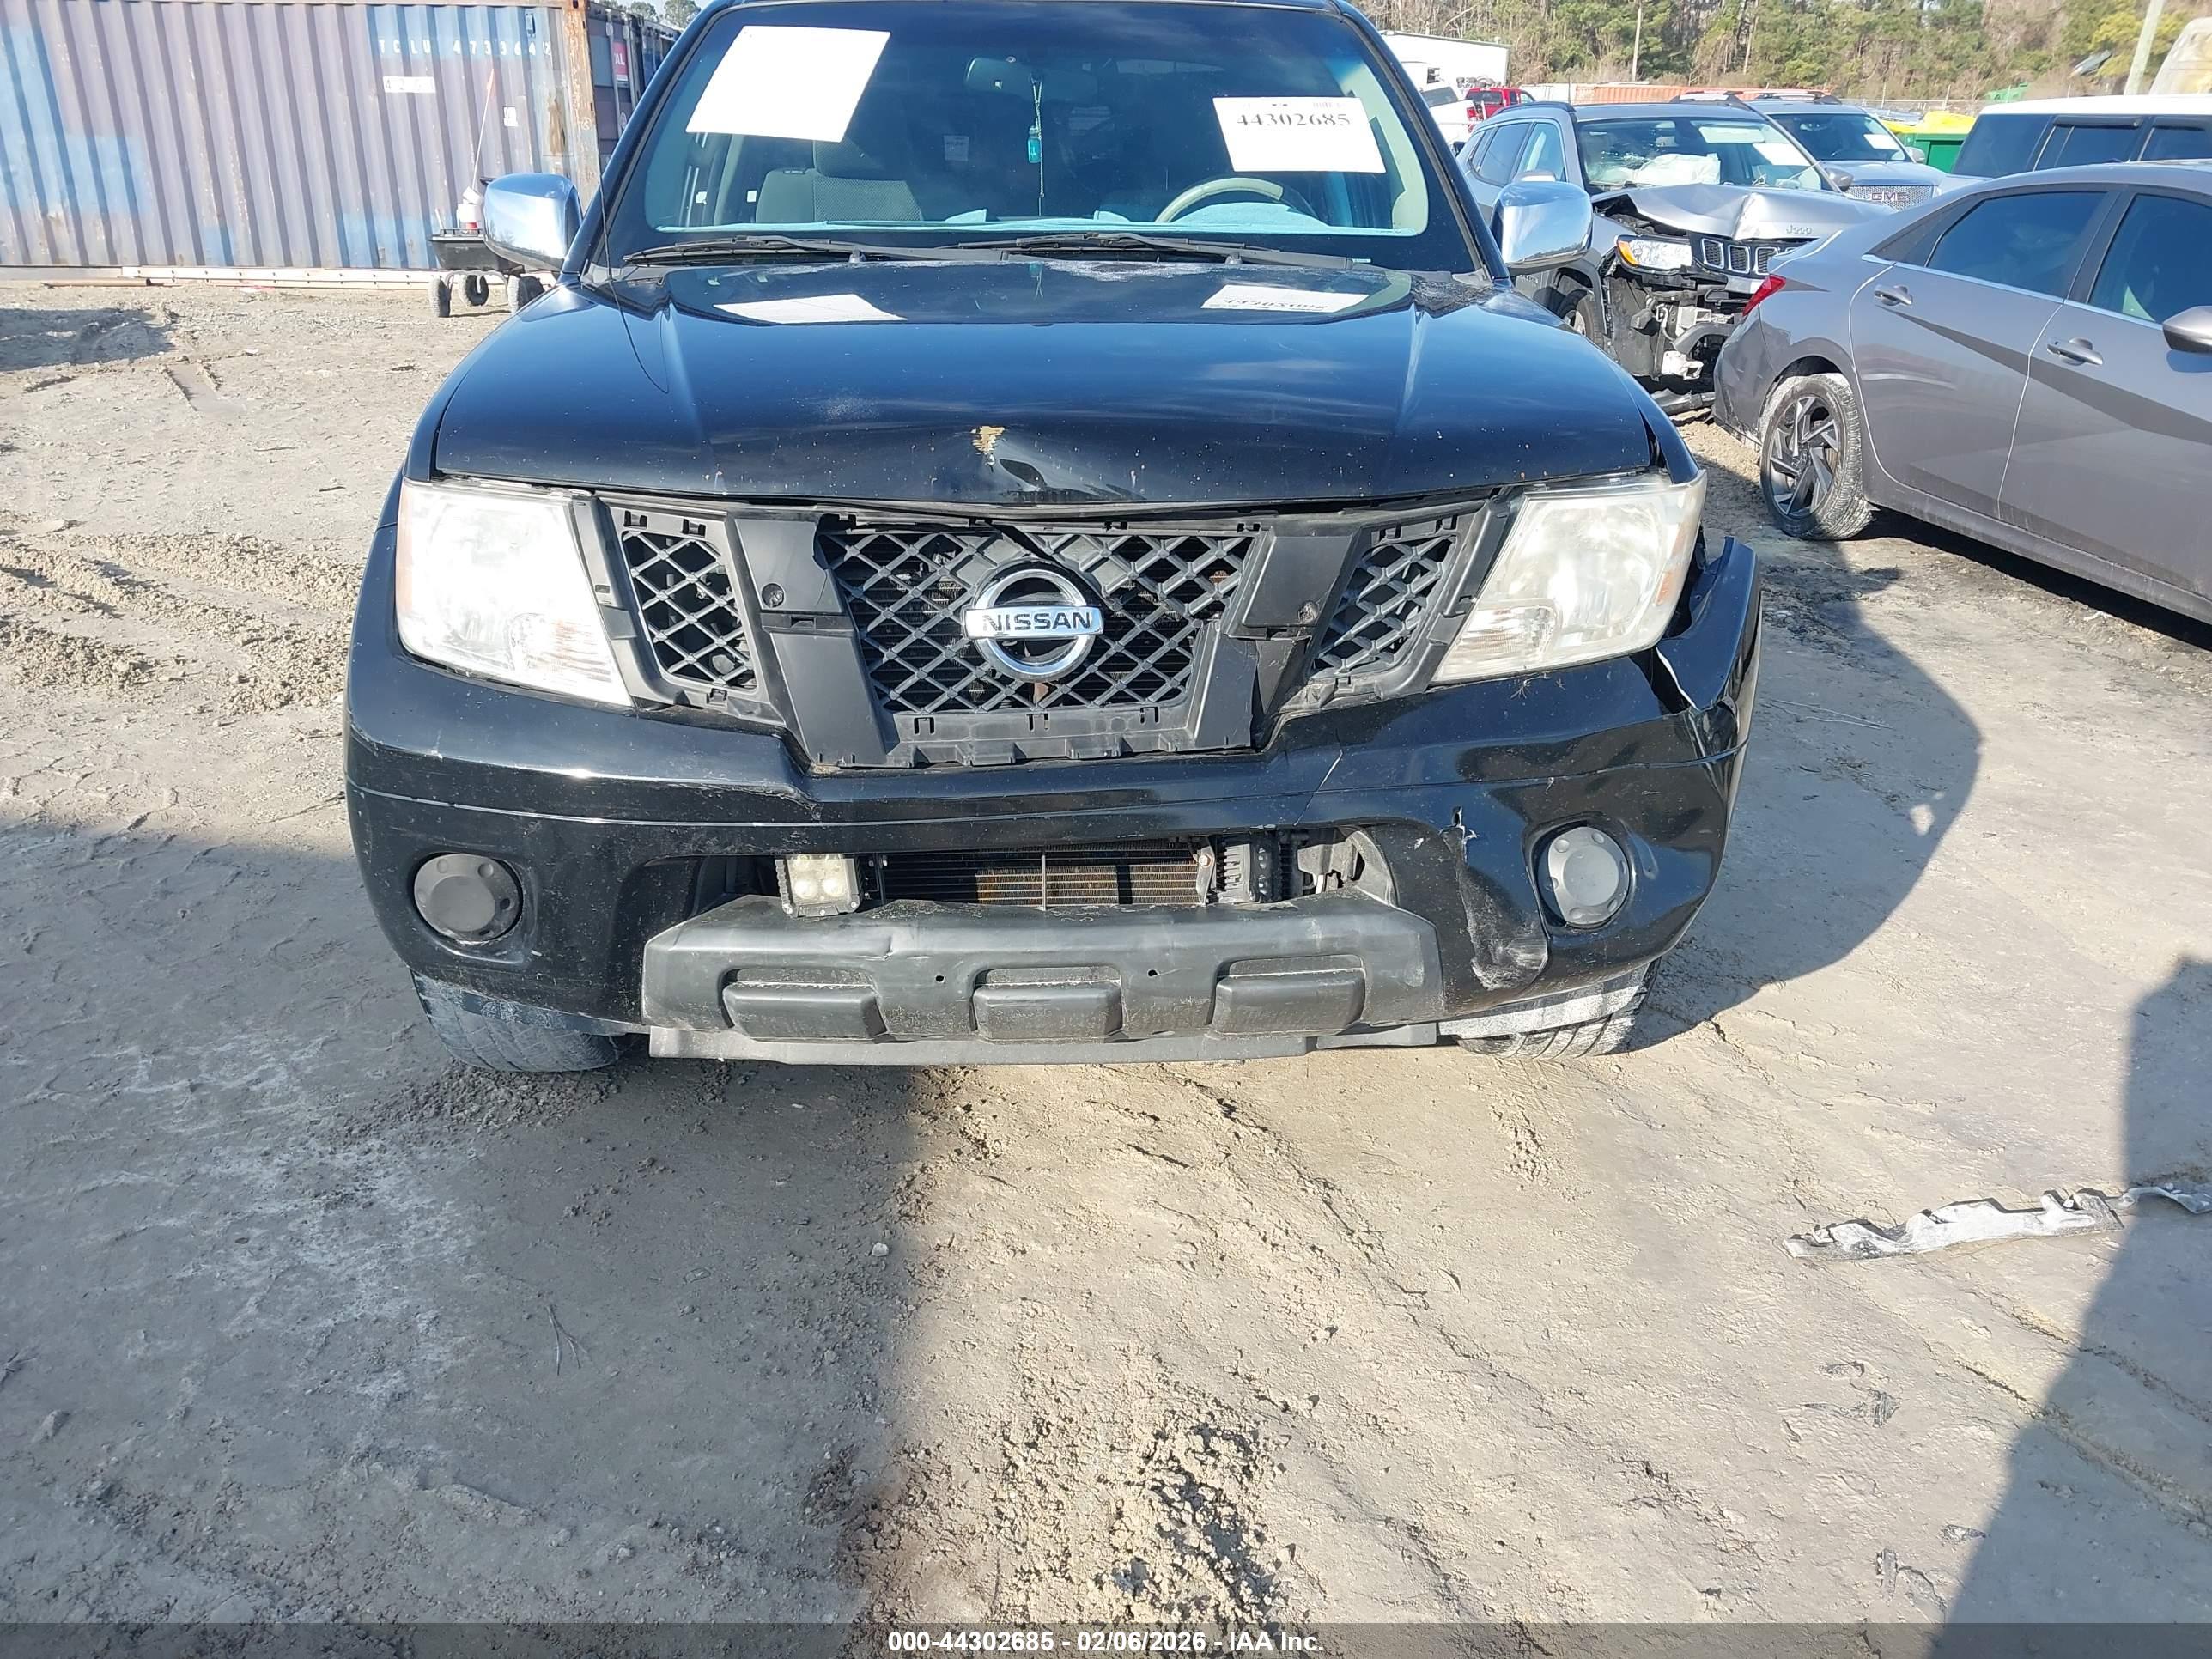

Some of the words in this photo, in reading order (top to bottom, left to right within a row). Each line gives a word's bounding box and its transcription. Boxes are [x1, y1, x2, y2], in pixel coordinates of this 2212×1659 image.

[1237, 113, 1351, 126] 44302685
[1870, 191, 1909, 202] GMC
[1786, 224, 1812, 234] Jeep
[982, 611, 1091, 632] NISSAN
